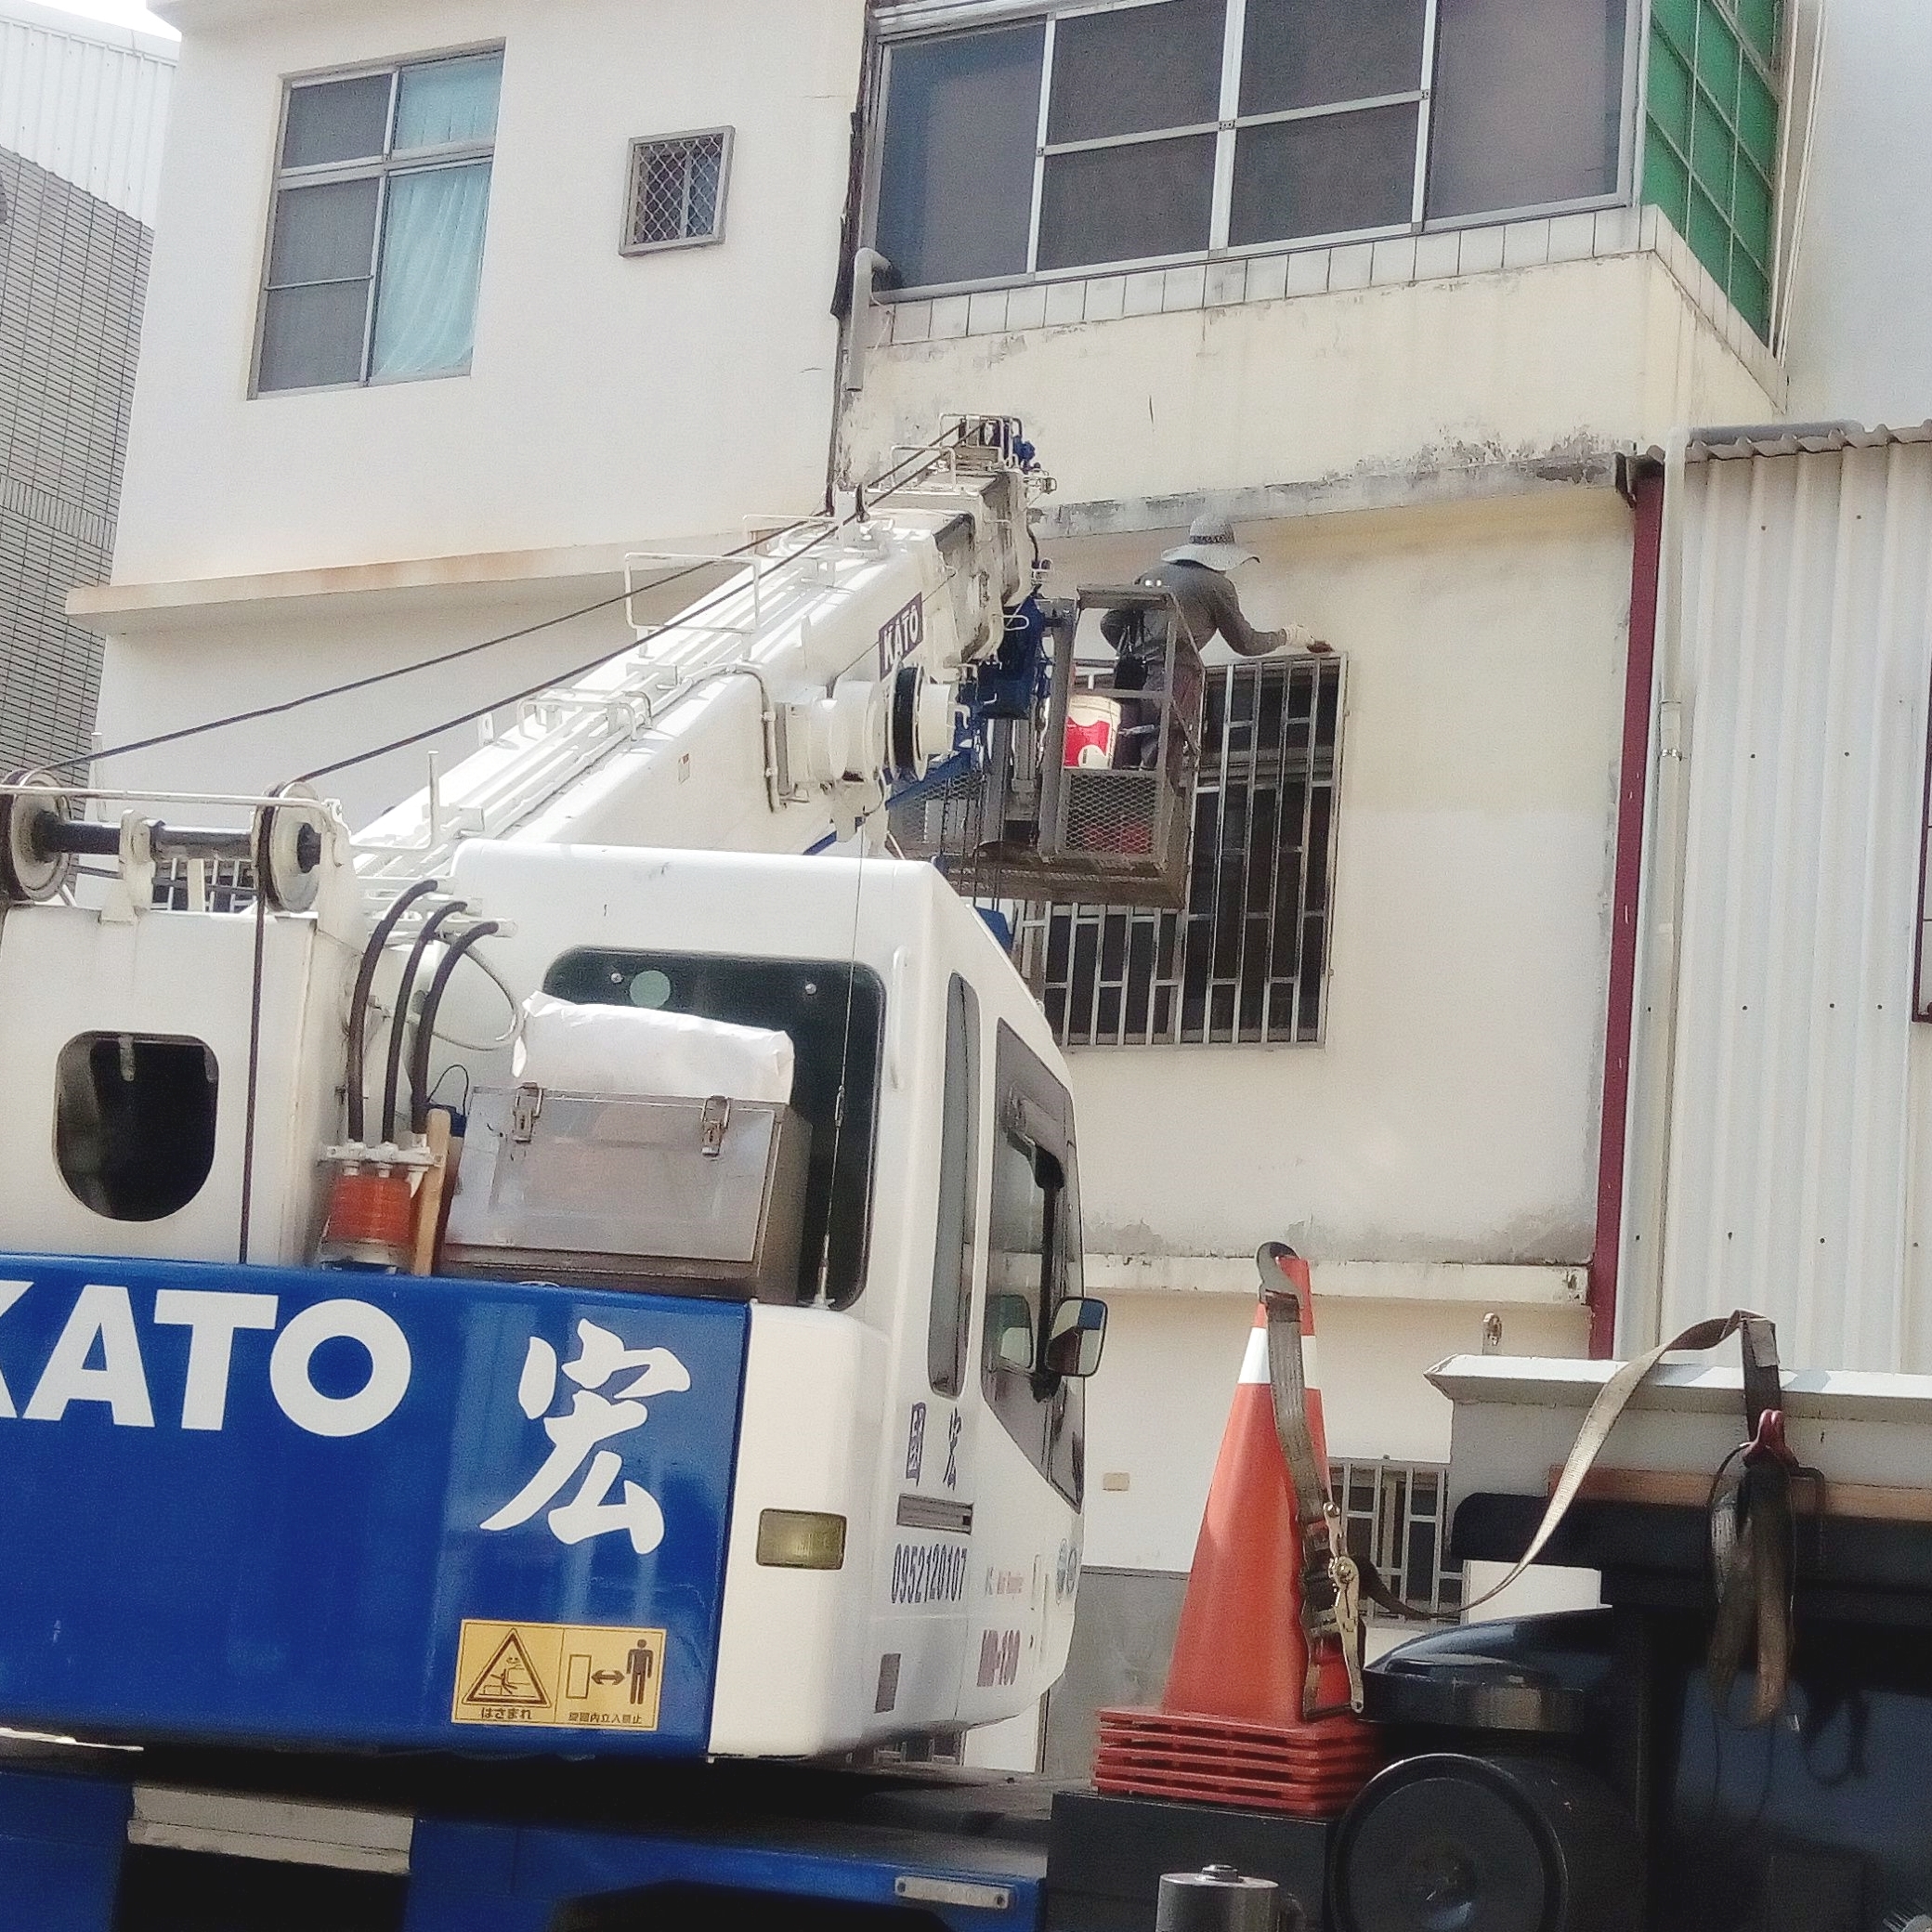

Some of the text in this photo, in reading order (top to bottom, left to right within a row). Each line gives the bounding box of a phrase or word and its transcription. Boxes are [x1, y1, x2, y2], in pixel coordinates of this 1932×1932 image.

[884, 604, 918, 672] KATO
[480, 1318, 691, 1554] 宏
[891, 1543, 968, 1604] 0952120107
[481, 1707, 532, 1720] はさまれ
